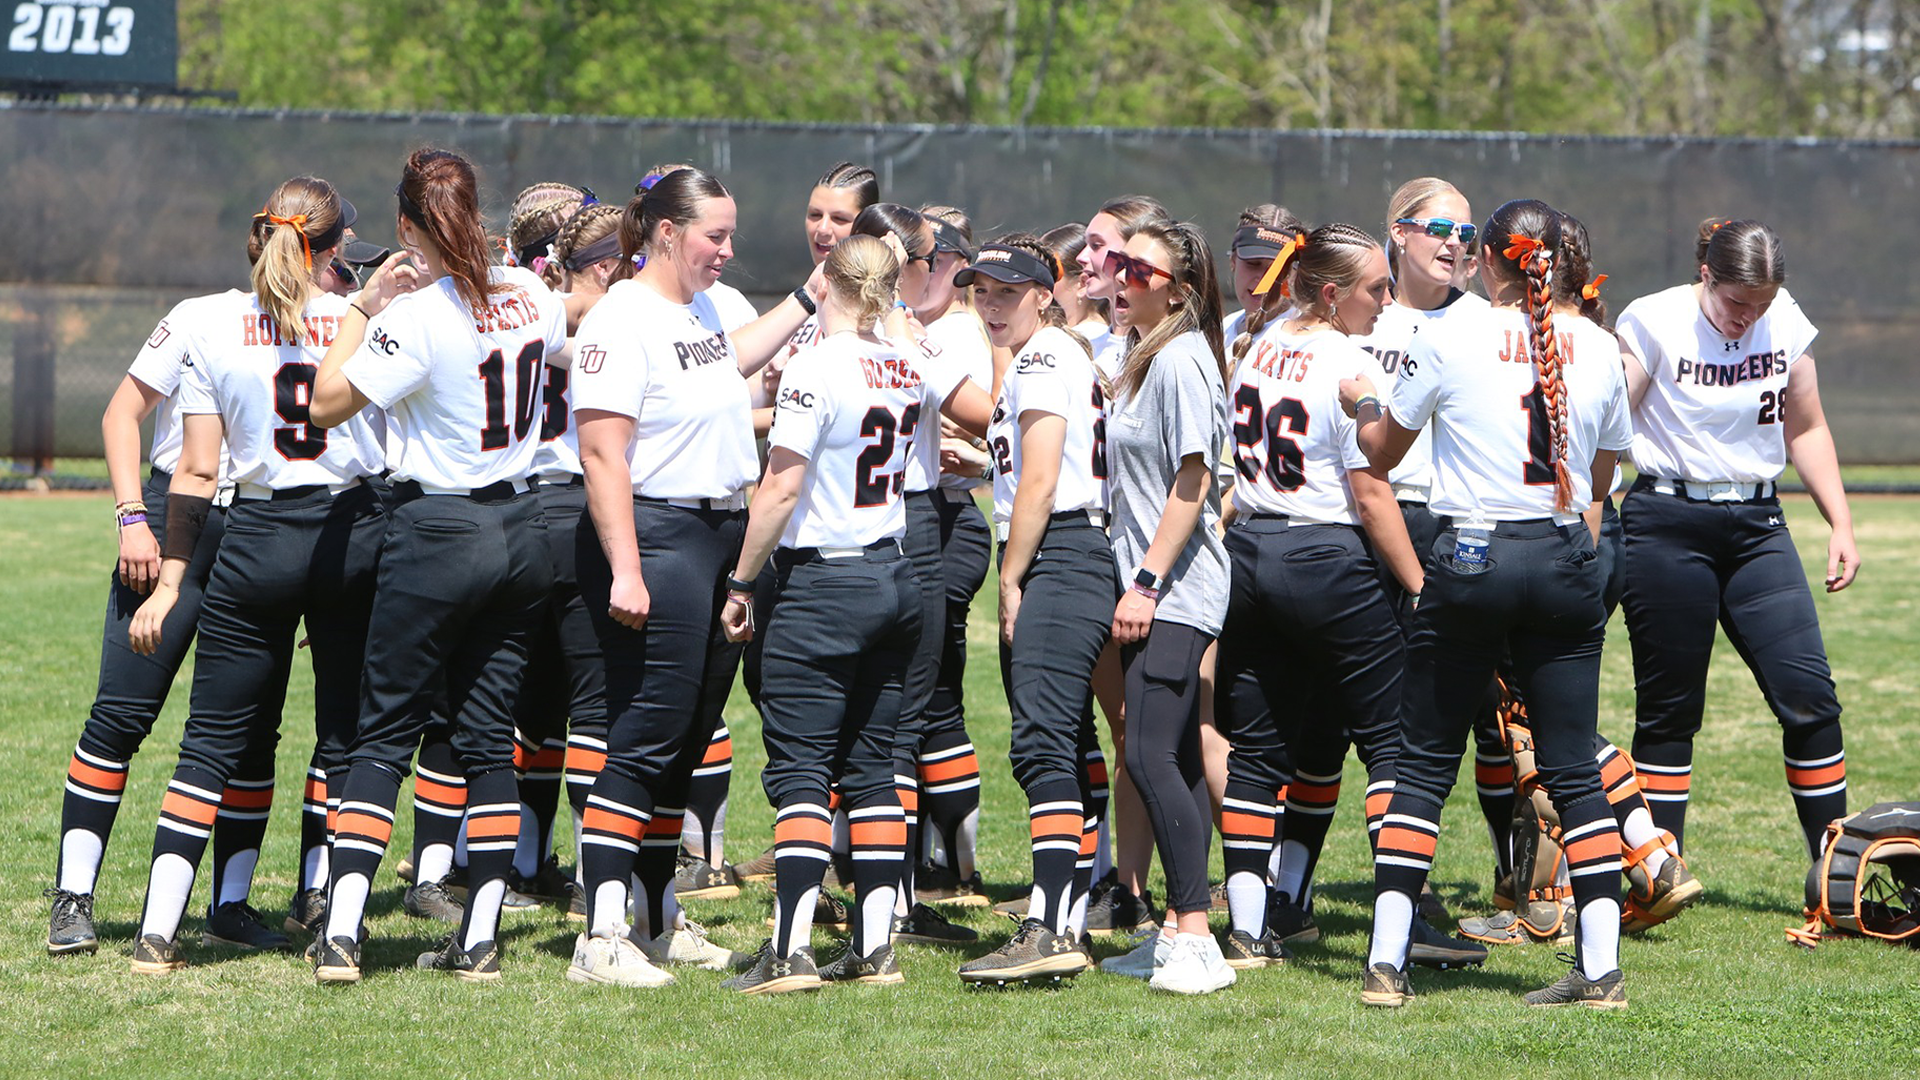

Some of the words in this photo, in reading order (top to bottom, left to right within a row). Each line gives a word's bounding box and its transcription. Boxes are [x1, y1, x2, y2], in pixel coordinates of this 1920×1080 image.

[8, 2, 135, 56] 2013
[371, 326, 400, 356] SAC
[579, 344, 606, 374] TU
[1019, 352, 1056, 370] SAC
[1675, 349, 1788, 387] PIONEERS
[478, 337, 546, 452] 10
[780, 387, 815, 409] SAC
[272, 362, 328, 462] 9
[1233, 382, 1310, 494] 26
[1519, 380, 1560, 487] 1
[453, 955, 473, 966] UA
[1251, 943, 1266, 955] UA
[856, 962, 876, 974] UA
[1583, 985, 1604, 996] UA
